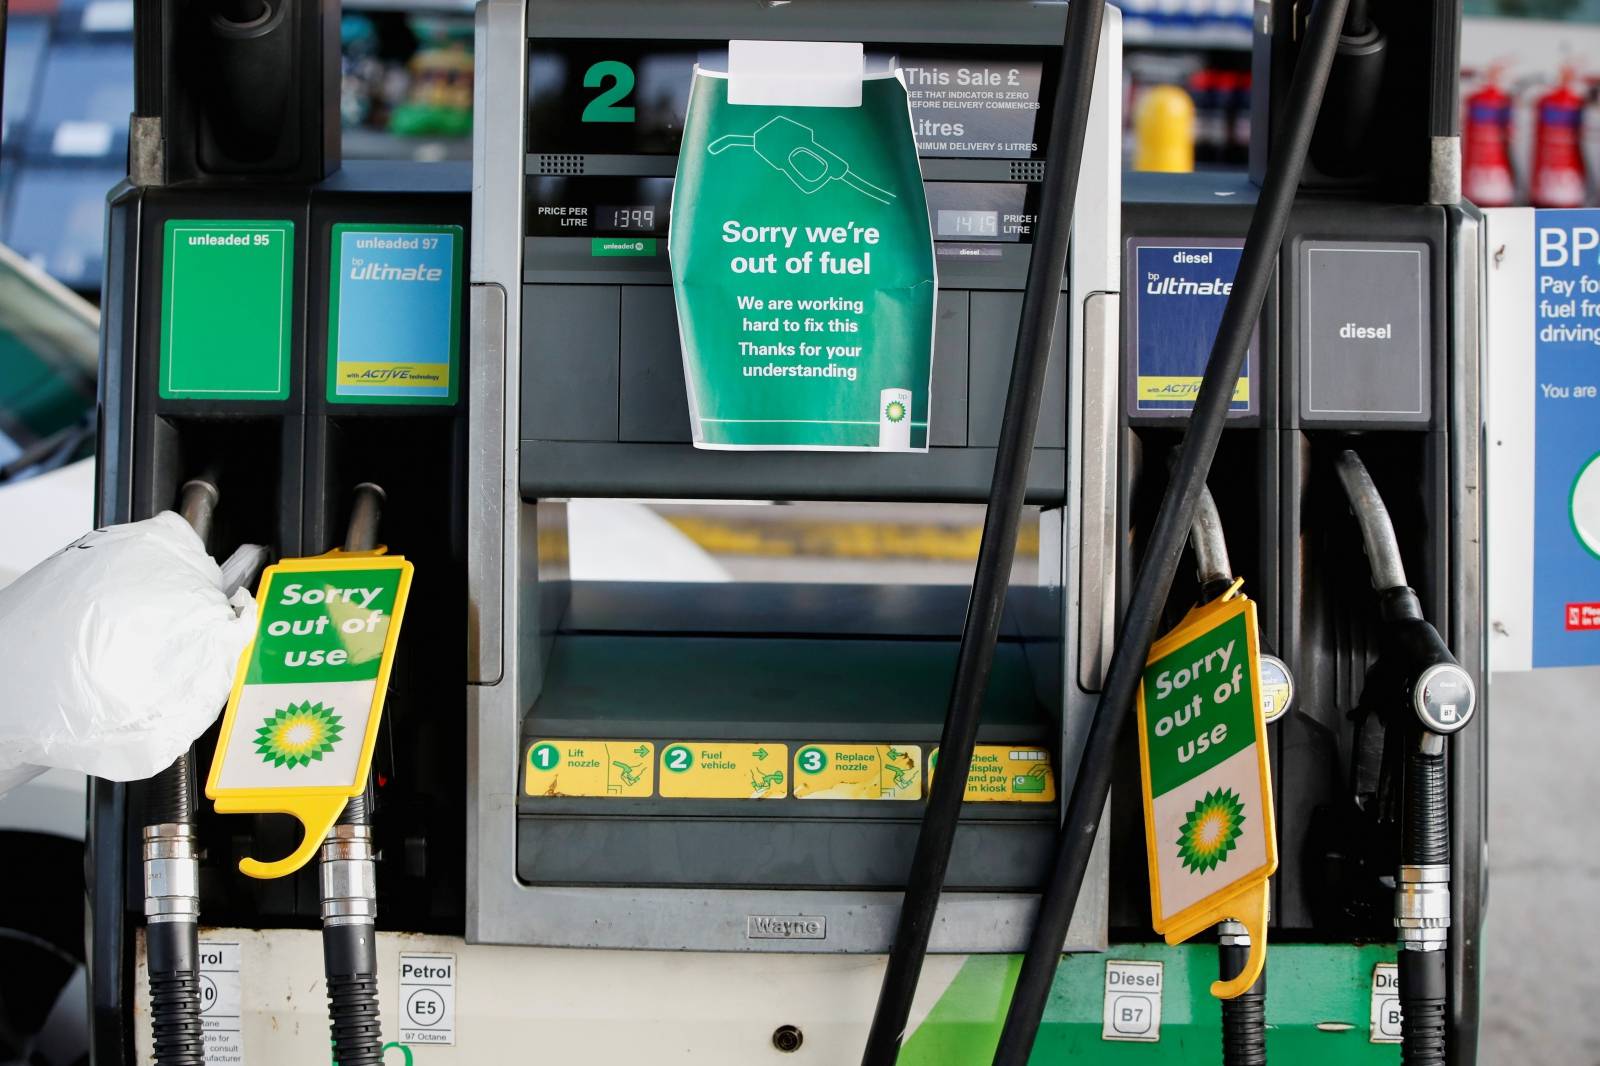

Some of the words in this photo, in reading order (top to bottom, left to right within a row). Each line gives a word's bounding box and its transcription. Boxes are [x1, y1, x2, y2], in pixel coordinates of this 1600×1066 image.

[905, 68, 950, 85] This
[957, 68, 1001, 86] Sale
[1007, 69, 1020, 86] £
[582, 60, 635, 122] 2
[926, 91, 947, 99] THAT
[949, 91, 993, 99] INDICATOR
[943, 101, 984, 109] DELIVERY
[985, 102, 1040, 110] COMMENCES
[917, 142, 947, 150] NIMUM
[950, 142, 994, 150] DELIVERY
[1005, 143, 1038, 151] LITRES
[538, 207, 567, 215] PRICE
[568, 207, 588, 216] PER
[560, 218, 588, 227] LITRE
[1003, 215, 1031, 223] PRICE
[722, 220, 797, 248] Sorry
[805, 221, 880, 245] we're
[1003, 226, 1030, 234] LITRE
[188, 233, 250, 246] unleaded
[253, 234, 269, 246] 95
[356, 237, 418, 249] unleaded
[422, 238, 438, 250] 97
[1540, 227, 1600, 267] BP
[352, 256, 364, 267] bp
[730, 253, 777, 274] out
[785, 251, 813, 274] of
[819, 251, 871, 275] fuel
[1173, 252, 1213, 264] diesel
[350, 262, 443, 281] ultimate
[1147, 272, 1160, 282] bp
[1147, 277, 1233, 296] ultimate
[1540, 276, 1575, 297] Pay
[1580, 275, 1600, 294] fo
[737, 296, 764, 310] We
[768, 299, 793, 310] are
[798, 297, 864, 314] working
[1540, 299, 1576, 318] fuel
[743, 318, 779, 332] hard
[783, 319, 800, 332] to
[804, 318, 824, 332] fix
[828, 318, 858, 333] this
[1339, 323, 1392, 339] diesel
[738, 341, 796, 356] Thanks
[799, 342, 822, 356] for
[826, 345, 862, 359] your
[360, 368, 411, 379] ACTIVE
[743, 363, 858, 381] understanding
[1161, 384, 1201, 393] ACTIV
[1541, 383, 1569, 398] You
[1573, 385, 1597, 398] are
[280, 584, 384, 609] Sorry
[267, 615, 330, 636] out
[341, 609, 384, 634] of
[284, 649, 348, 667] use
[1156, 640, 1235, 700] Sorry
[1155, 694, 1203, 737] out
[1213, 664, 1243, 704] of
[1177, 723, 1228, 764] use
[537, 748, 550, 767] 1
[568, 749, 584, 757] Lift
[670, 749, 688, 769] 2
[701, 751, 722, 760] Fuel
[835, 752, 875, 763] Replace
[568, 760, 600, 768] nozzle
[701, 761, 736, 770] vehicle
[803, 751, 821, 771] 3
[835, 763, 869, 771] nozzle
[968, 774, 987, 782] and
[990, 775, 1008, 784] pay
[968, 783, 977, 792] in
[980, 784, 1007, 792] kiosk
[754, 918, 820, 936] Wayne
[402, 964, 451, 979] Petrol
[1109, 971, 1160, 986] Diesel
[415, 1001, 436, 1015] E5
[1122, 1008, 1143, 1022] B7
[1389, 1011, 1400, 1024] B
[219, 1034, 230, 1042] for
[418, 1033, 447, 1041] Octane
[210, 1044, 239, 1053] consult
